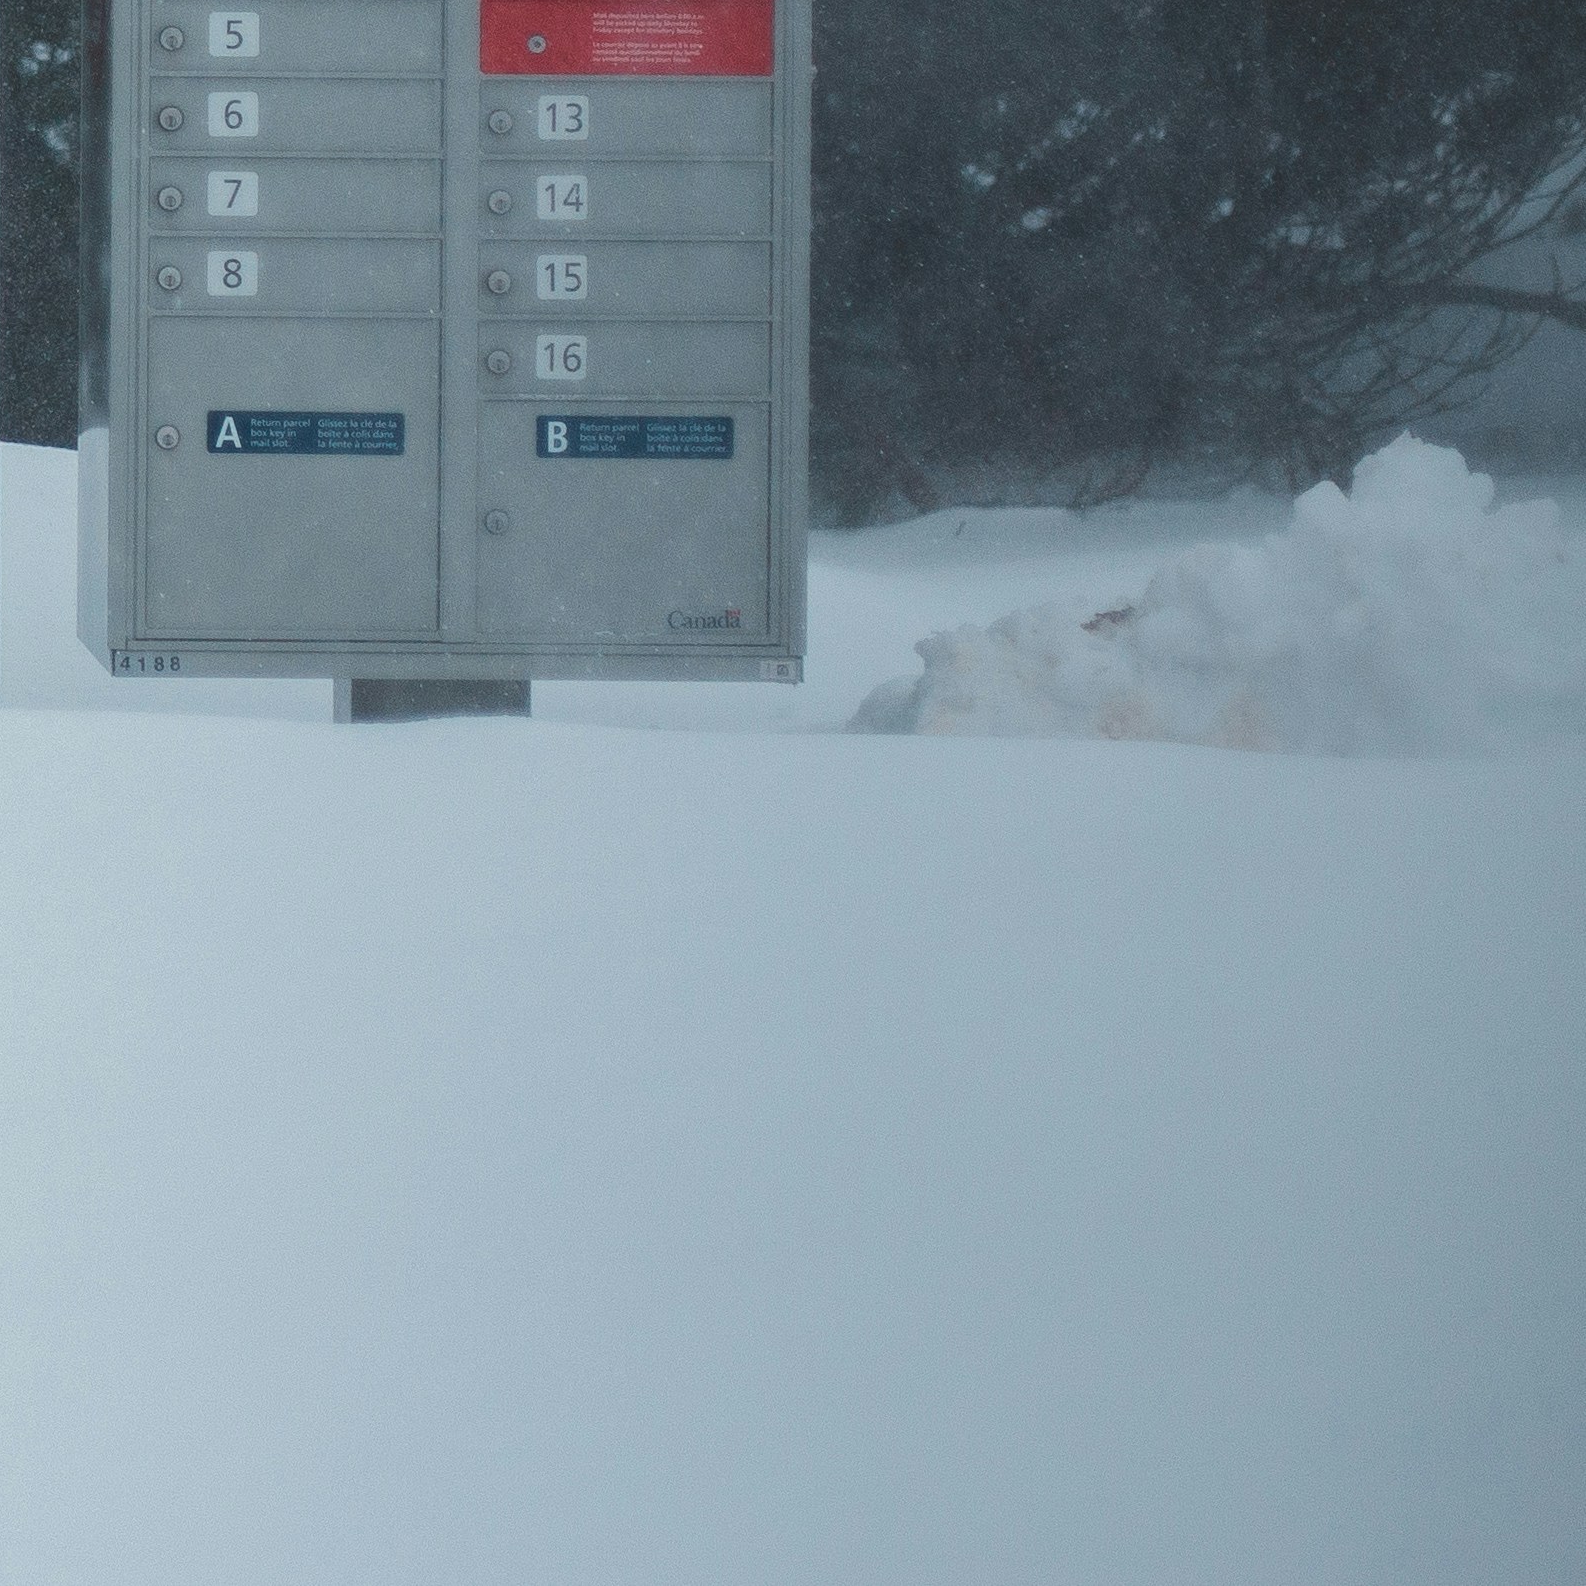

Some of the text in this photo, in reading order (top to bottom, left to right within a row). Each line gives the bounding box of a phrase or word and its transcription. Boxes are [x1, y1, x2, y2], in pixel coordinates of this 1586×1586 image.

[226, 19, 244, 50] 5
[224, 99, 243, 130] 6
[546, 102, 584, 134] 13
[223, 178, 243, 209] 7
[544, 183, 584, 213] 14
[222, 258, 243, 289] 8
[544, 262, 582, 293] 15
[544, 342, 582, 373] 16
[215, 416, 242, 448] A
[547, 421, 568, 453] B
[668, 609, 742, 629] Canada
[120, 656, 180, 672] 4188
